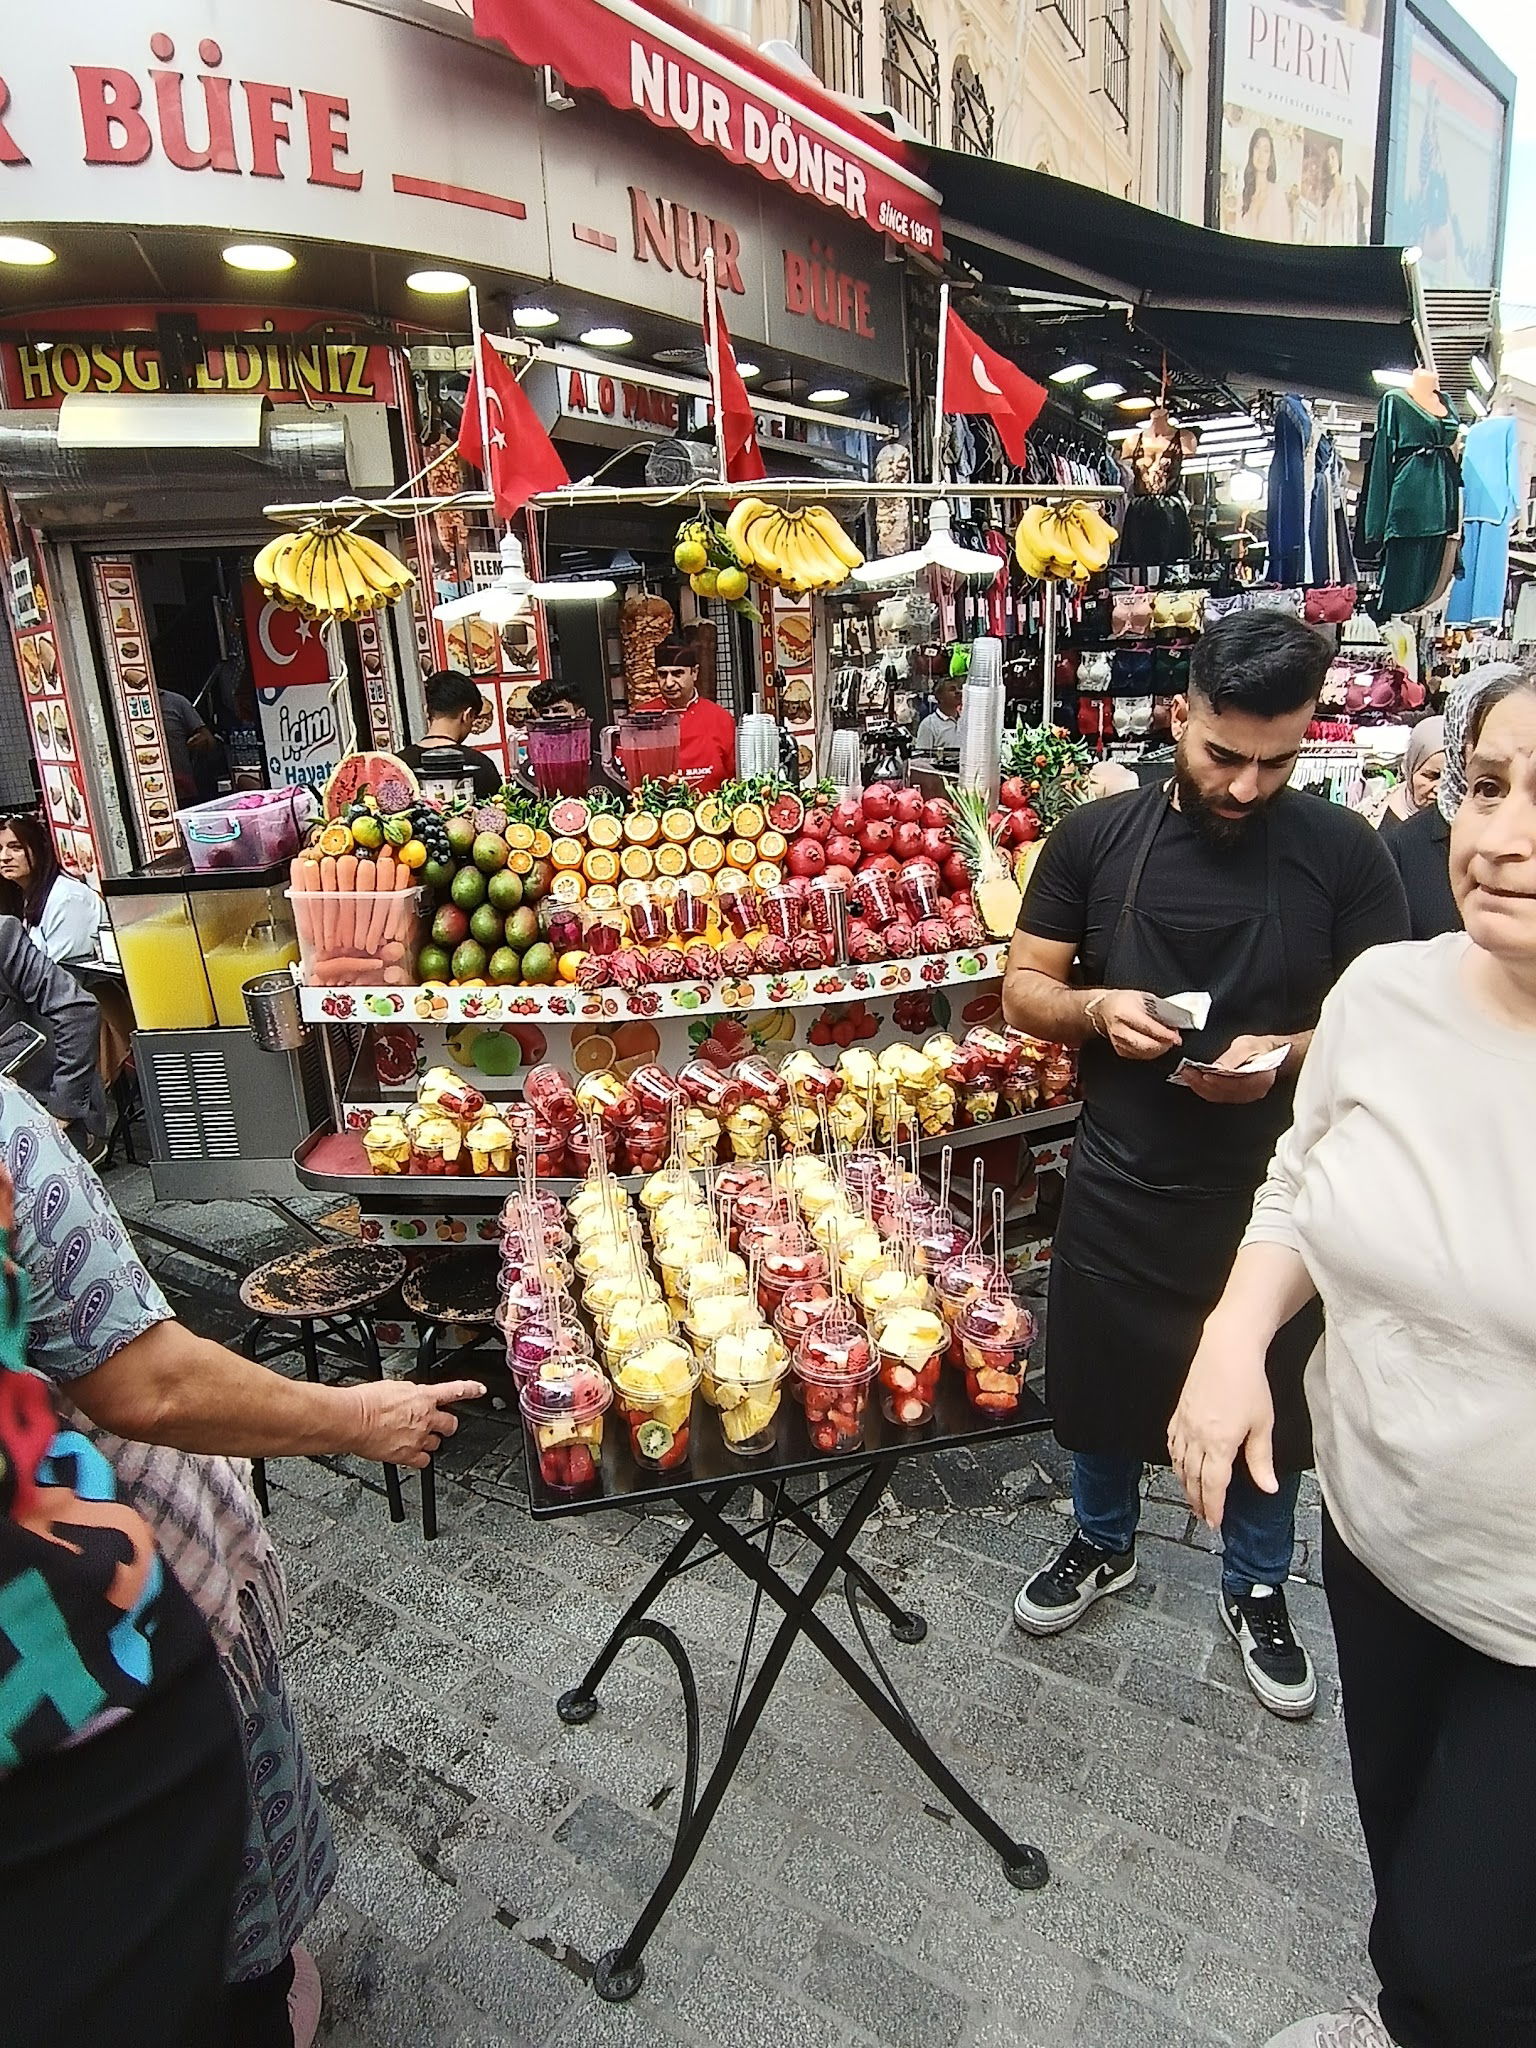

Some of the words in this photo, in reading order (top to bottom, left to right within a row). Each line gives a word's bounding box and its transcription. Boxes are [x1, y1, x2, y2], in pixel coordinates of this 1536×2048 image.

[71, 32, 364, 192] BÜFE
[630, 39, 733, 151] NUR
[744, 102, 868, 218] DÖNER
[628, 186, 746, 295] NUR
[782, 238, 875, 339] BÜFE
[910, 219, 933, 248] 1987
[284, 760, 338, 787] Hayat
